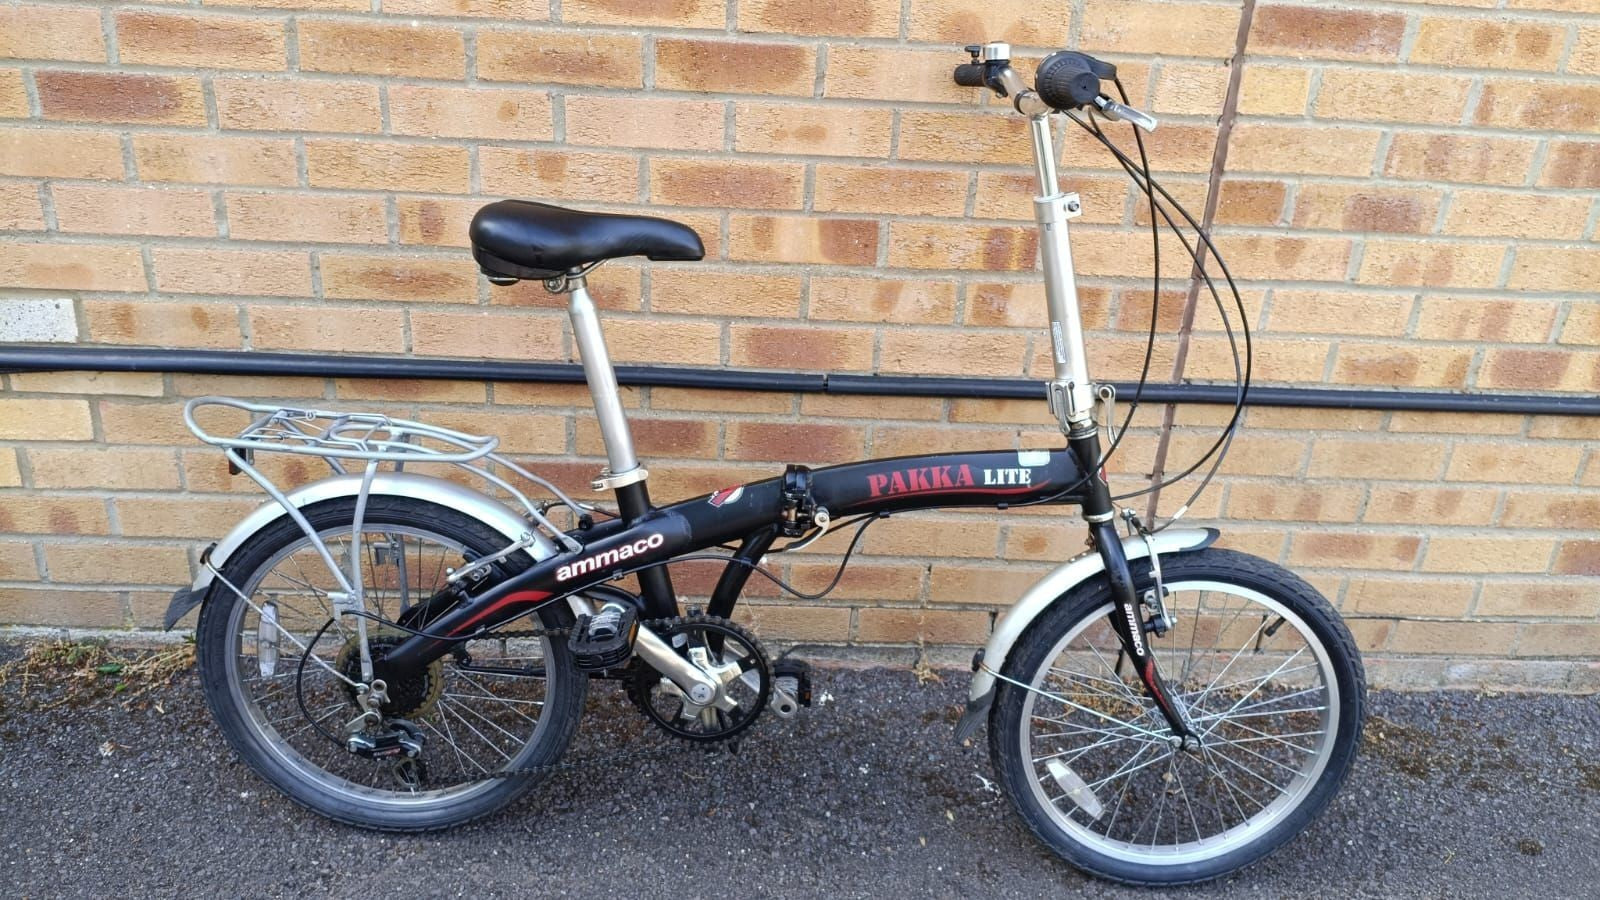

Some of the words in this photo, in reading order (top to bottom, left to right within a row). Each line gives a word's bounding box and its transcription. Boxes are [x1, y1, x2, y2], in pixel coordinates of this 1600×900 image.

[866, 463, 975, 498] PAKKA
[983, 468, 1032, 486] LITE
[555, 533, 665, 582] ammaco
[1123, 603, 1145, 657] ammaco
